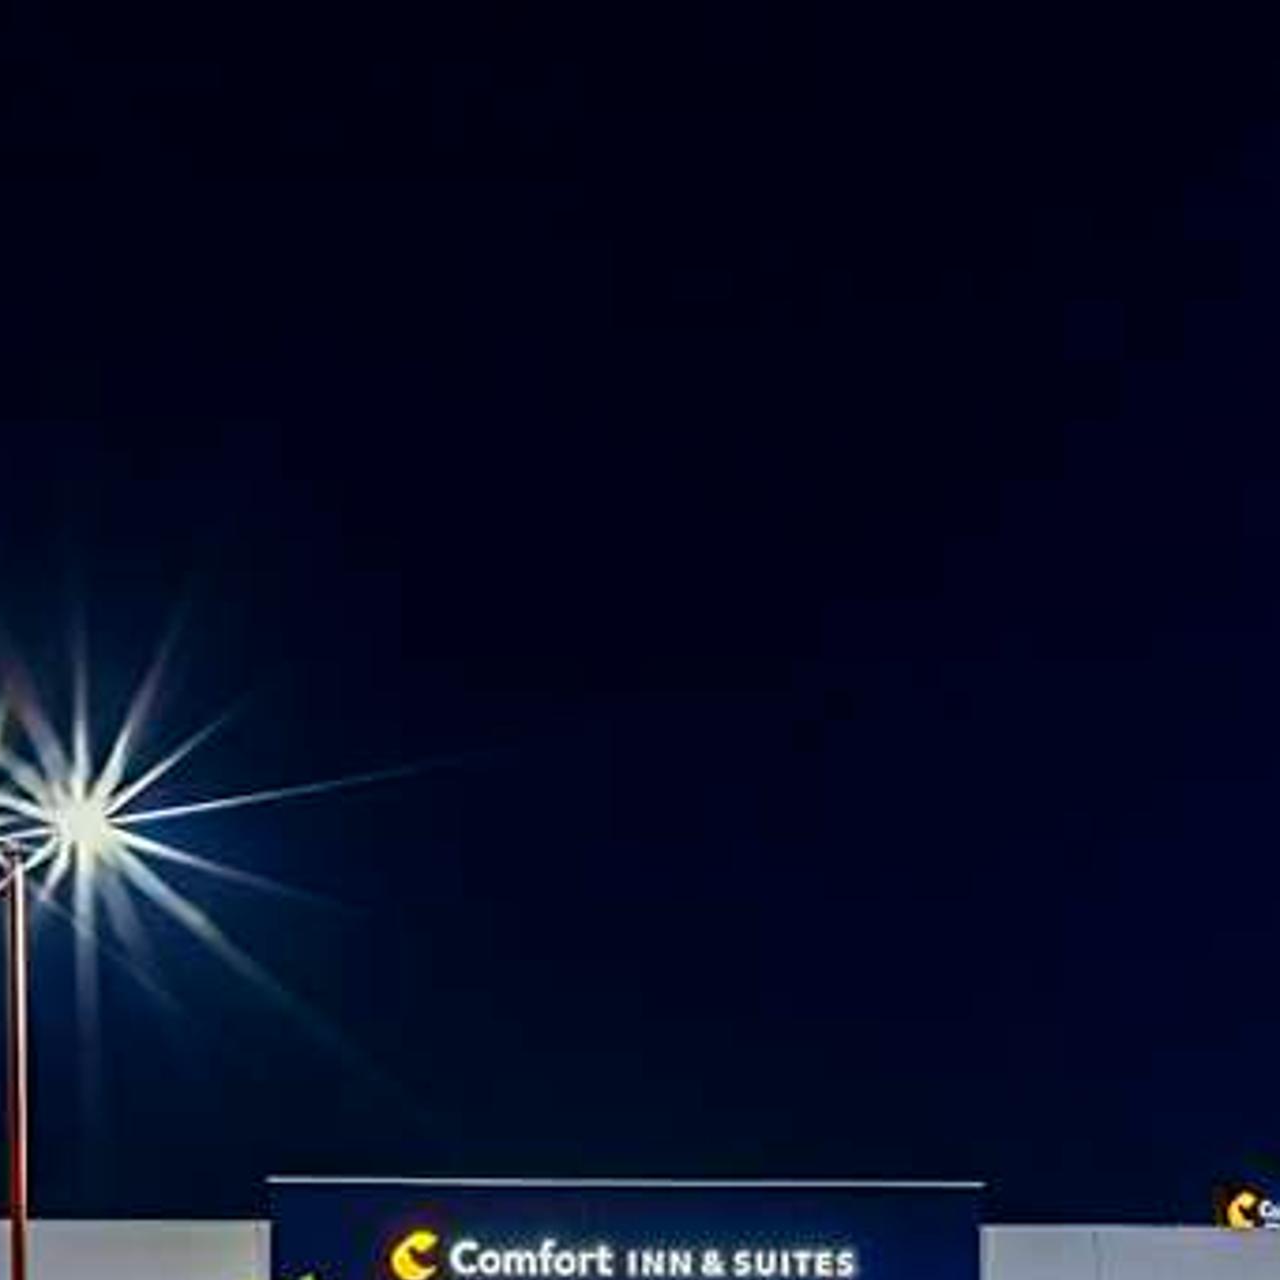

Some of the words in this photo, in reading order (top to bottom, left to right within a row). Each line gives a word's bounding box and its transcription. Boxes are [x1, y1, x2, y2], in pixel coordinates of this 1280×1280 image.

[448, 1237, 614, 1278] Comfort
[626, 1248, 693, 1278] INN
[700, 1248, 726, 1278] &
[732, 1248, 856, 1279] SUITES
